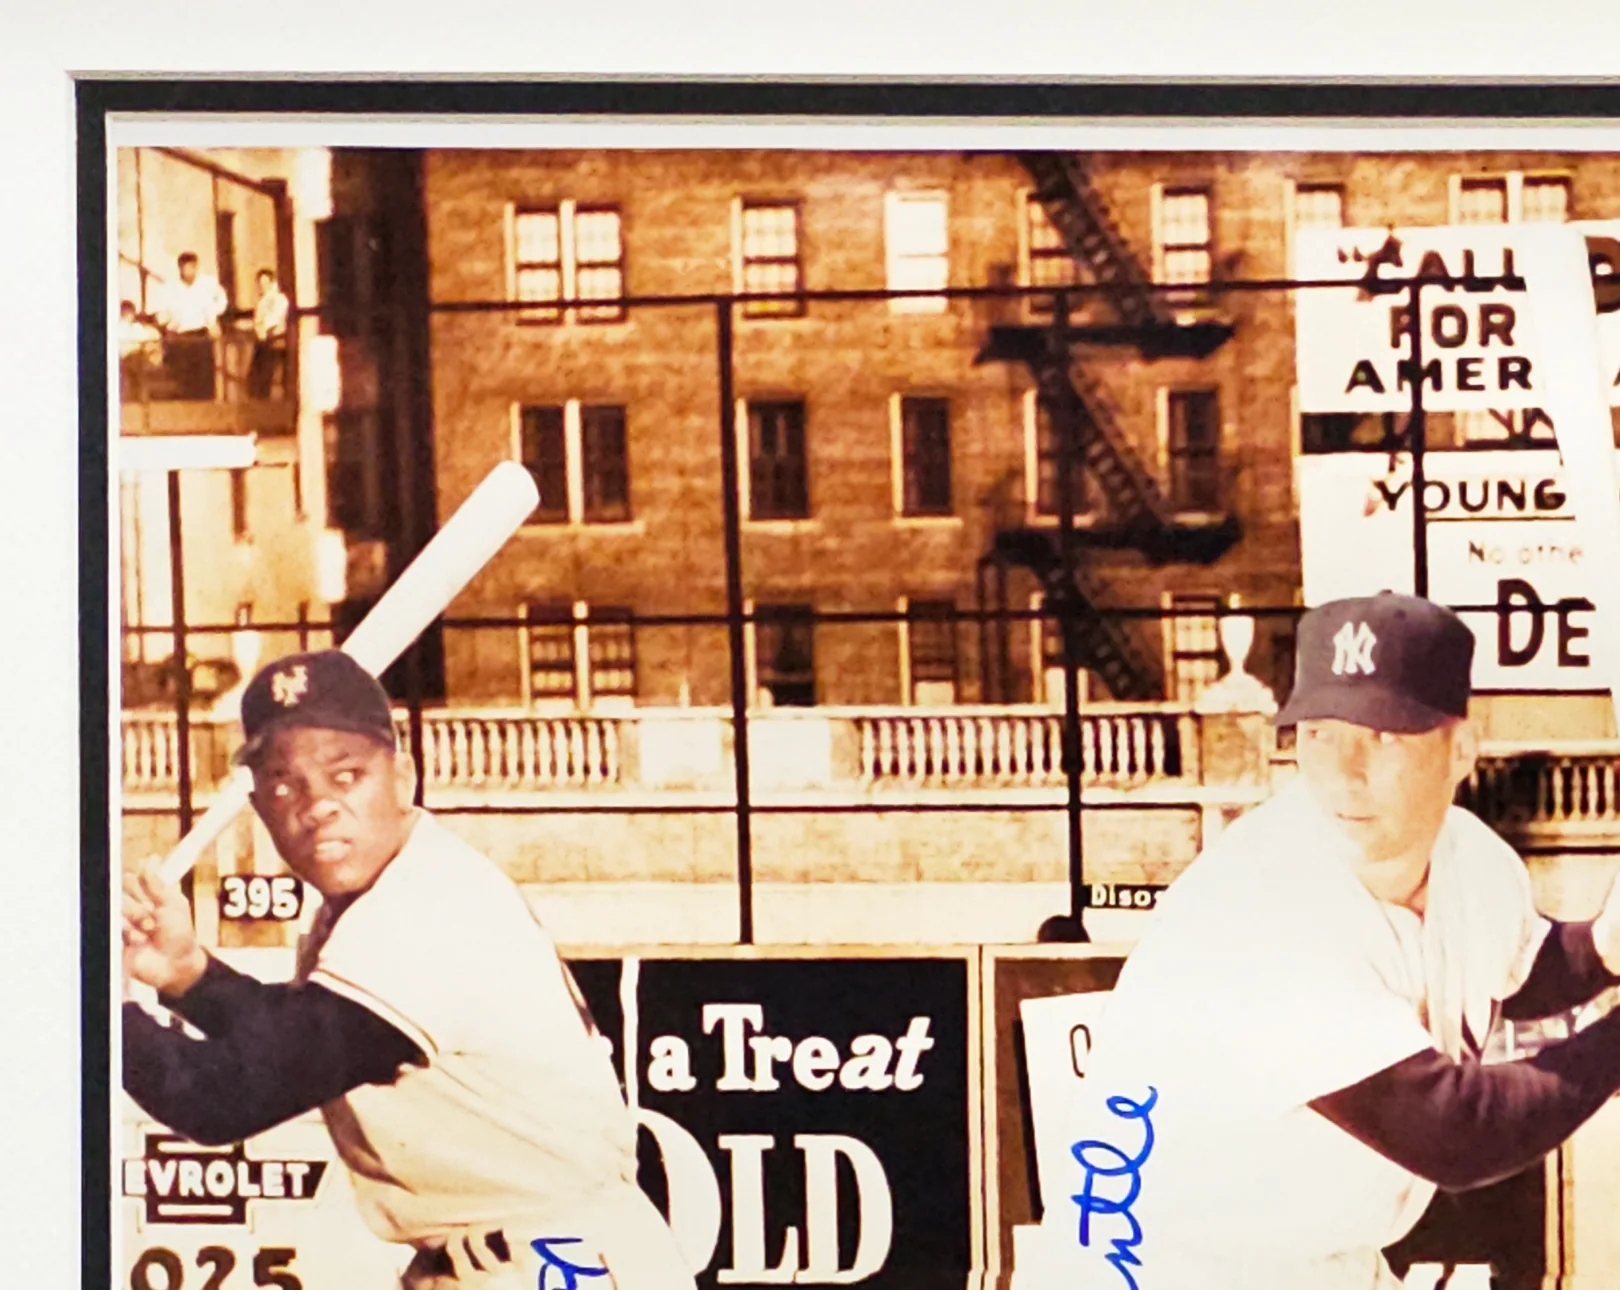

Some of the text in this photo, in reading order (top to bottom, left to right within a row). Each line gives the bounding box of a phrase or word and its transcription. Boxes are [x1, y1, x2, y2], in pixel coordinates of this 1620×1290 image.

[1390, 303, 1516, 349] FOR
[1373, 477, 1568, 513] YOUNG
[222, 876, 297, 920] 395
[647, 1003, 935, 1093] a Treat
[123, 1159, 311, 1198] EVROLET
